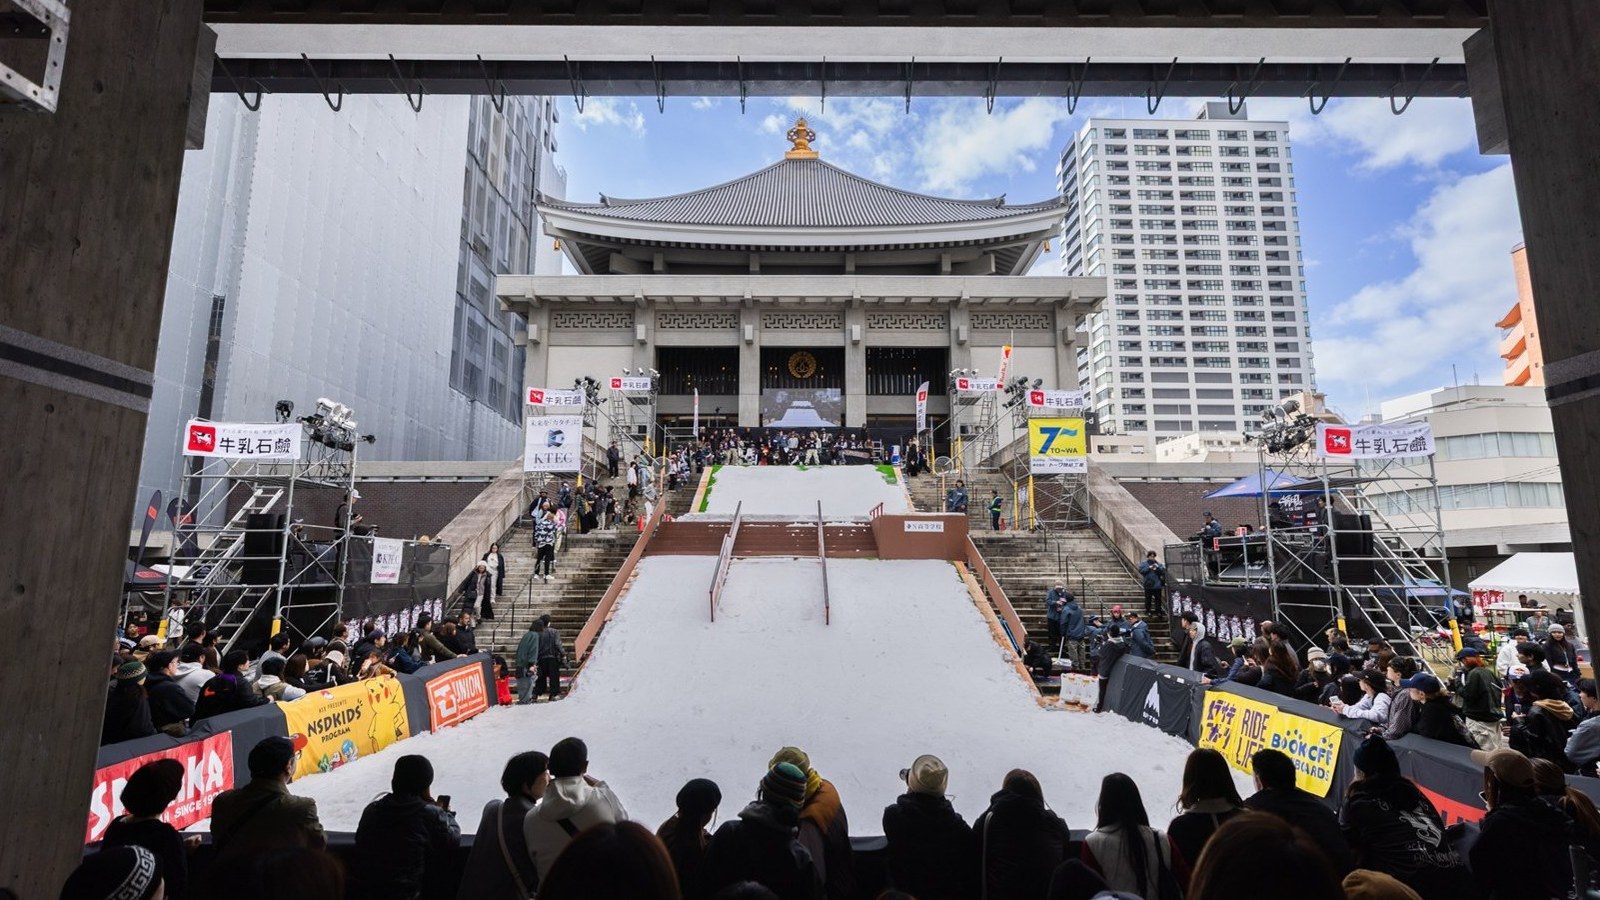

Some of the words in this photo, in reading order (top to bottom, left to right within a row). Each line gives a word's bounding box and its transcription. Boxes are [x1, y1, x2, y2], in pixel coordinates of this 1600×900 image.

[534, 452, 573, 464] KTEC
[451, 673, 482, 702] UNION
[307, 704, 362, 737] NSDKIDS
[1241, 708, 1270, 743] RIDE
[321, 727, 351, 743] PROGRAM
[174, 801, 202, 819] SINCE
